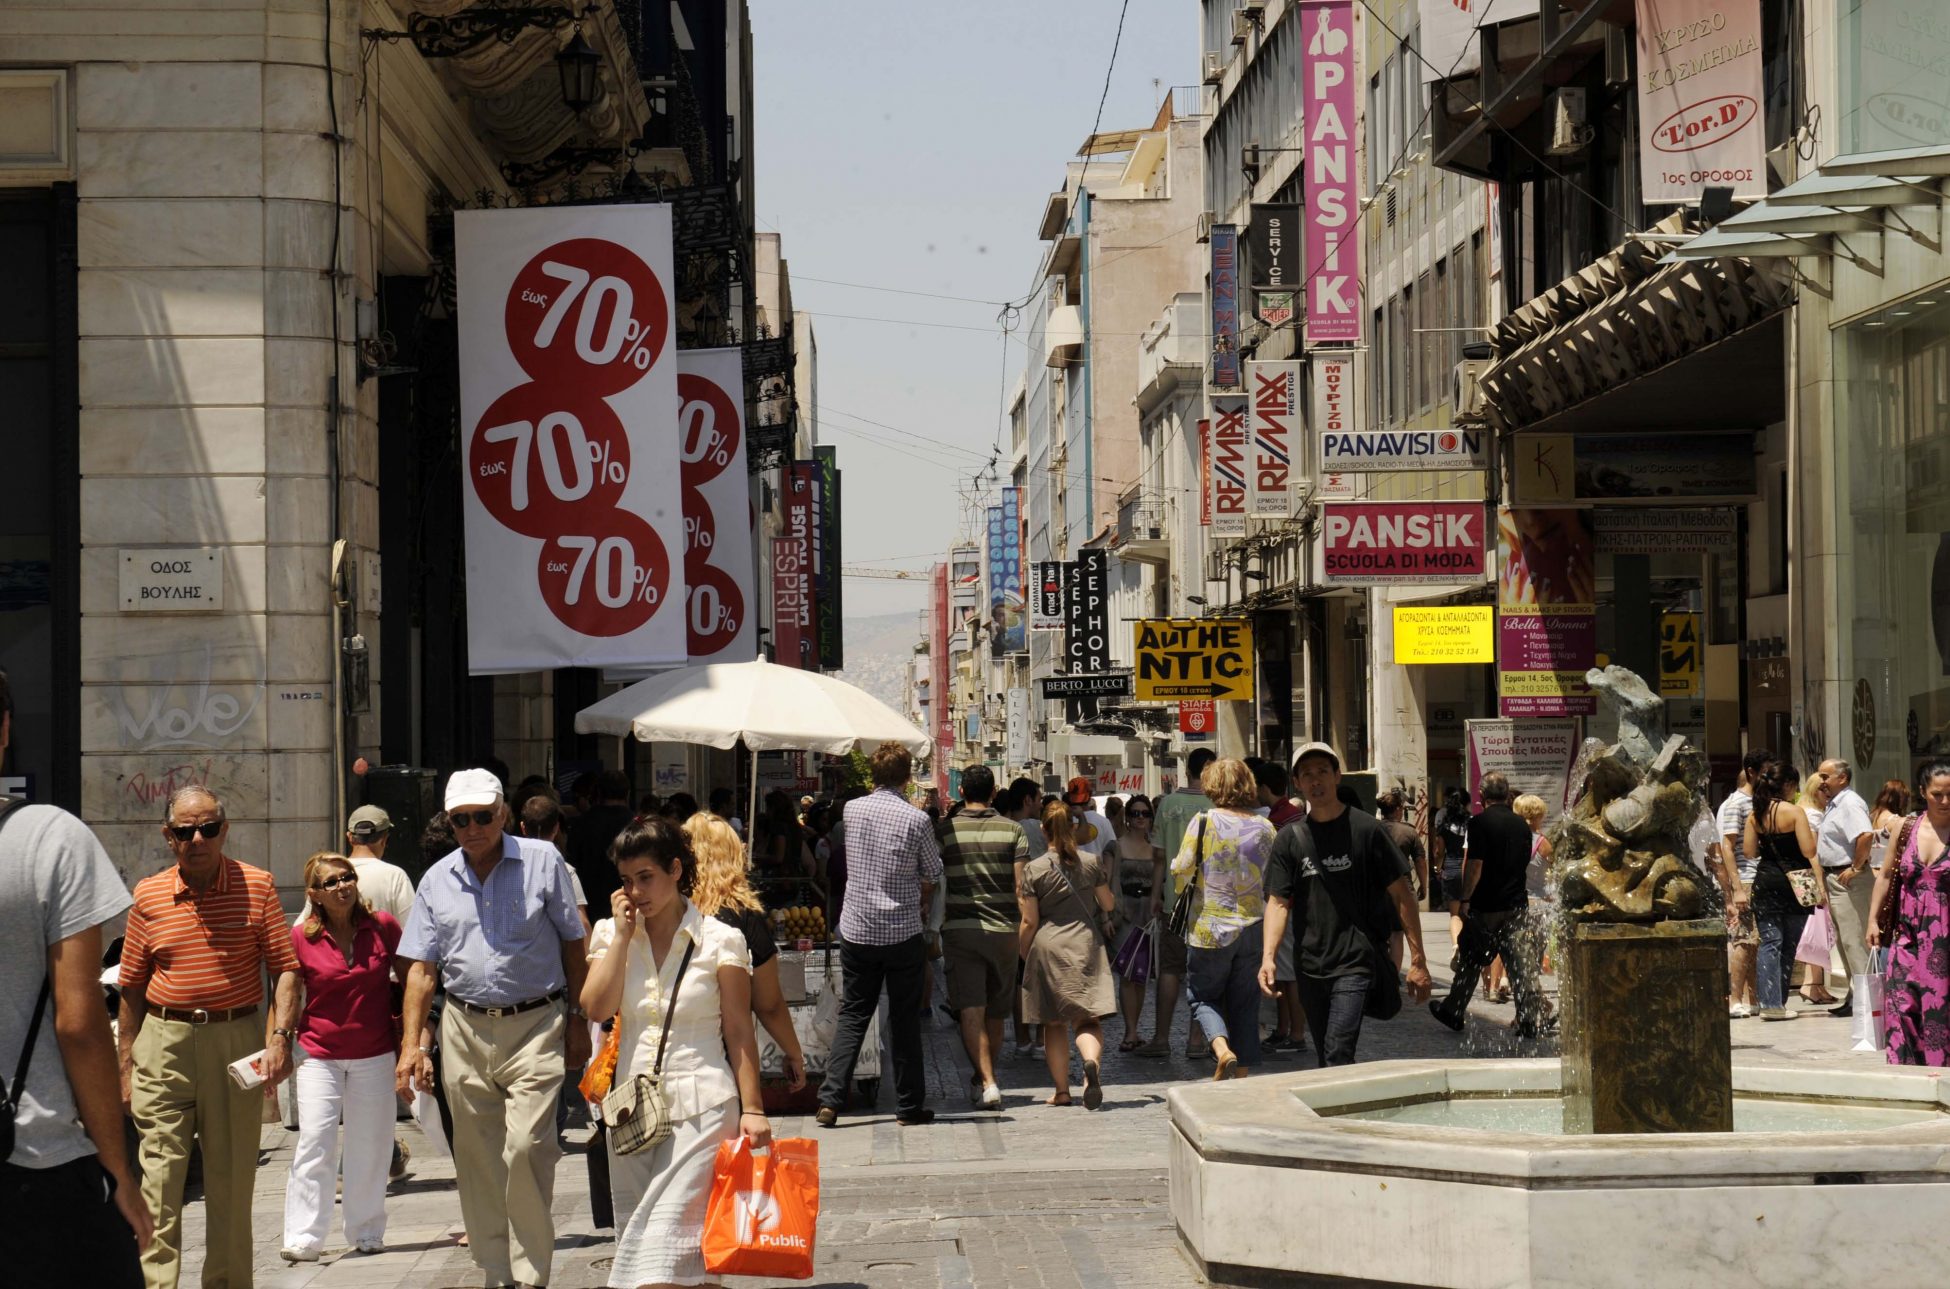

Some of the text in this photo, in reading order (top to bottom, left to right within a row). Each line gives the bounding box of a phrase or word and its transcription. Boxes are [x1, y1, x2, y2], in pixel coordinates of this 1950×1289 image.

[1655, 13, 1726, 55] ΧΡΥΣΟ
[1644, 34, 1759, 95] ΚΟΣΜΗΜΑ
[1690, 169, 1753, 183] ΟΡΟΦΟΣ
[1269, 219, 1282, 286] SERVICE
[521, 260, 651, 370] έως 70%
[677, 395, 728, 467] 0%
[480, 410, 626, 512] έως 70%
[151, 561, 192, 573] ΟΔΟΣ
[547, 560, 568, 573] έως
[1326, 552, 1475, 569] SCUOLA DI MODA
[557, 535, 658, 608] 70%
[141, 586, 202, 599] ΒΟΥΛΗΣ
[775, 541, 799, 629] ESPRIT
[1045, 564, 1055, 614] mad hair
[1088, 556, 1104, 671] SEPHOR
[1504, 618, 1540, 630] Bella
[1140, 651, 1243, 680] NTIC
[1047, 679, 1124, 690] BERTO LUCCI
[1182, 700, 1212, 708] STAFF
[1482, 734, 1567, 745] Τώρα Εντατικές
[1482, 745, 1567, 756] Σπουδές Μόδας
[1119, 775, 1144, 790] H&M
[760, 1234, 807, 1248] Public
